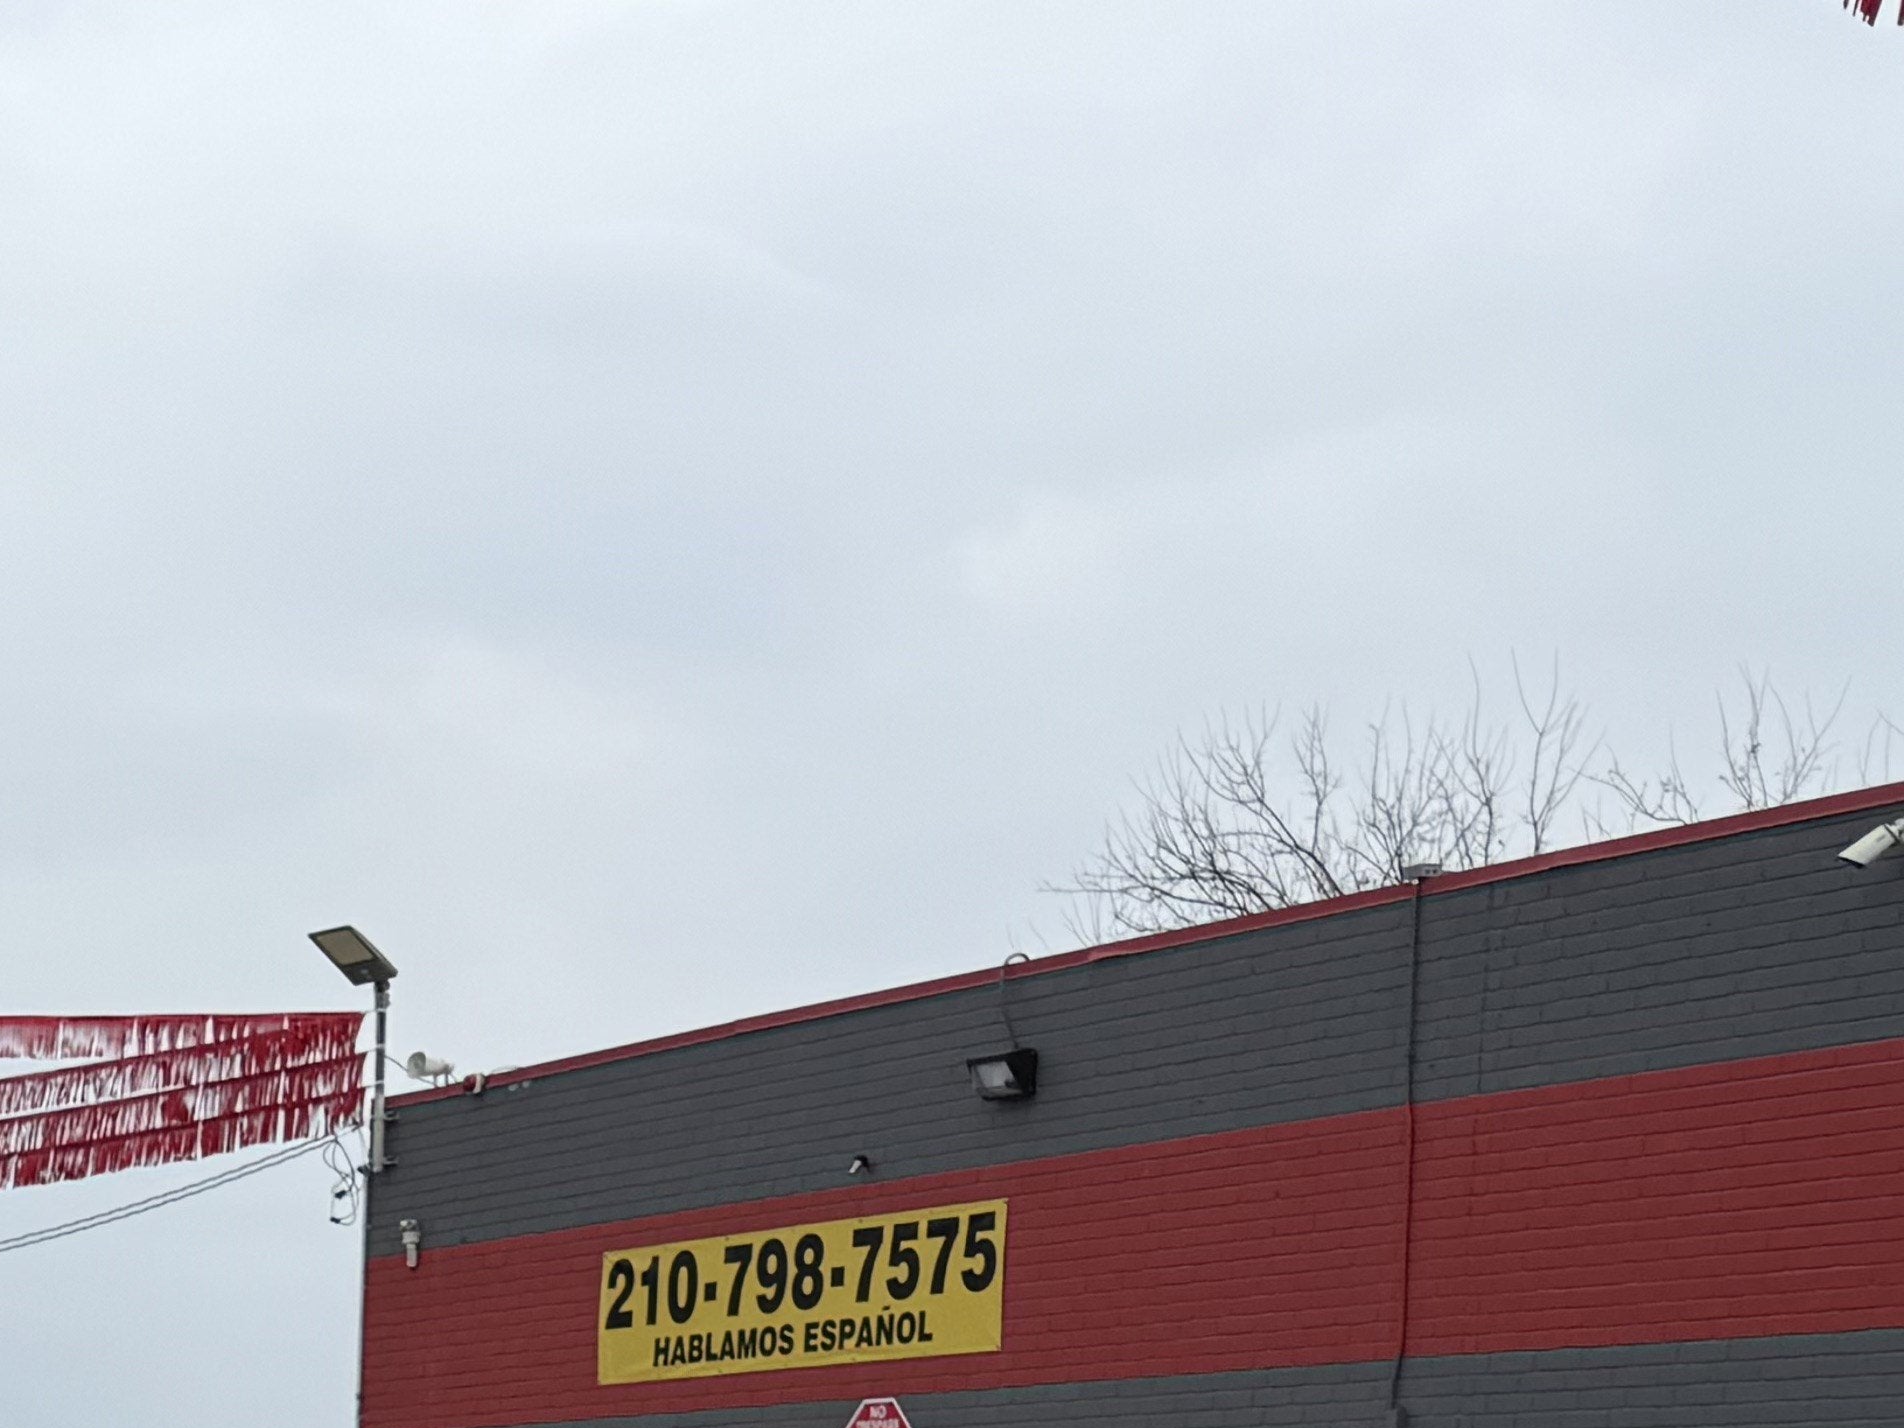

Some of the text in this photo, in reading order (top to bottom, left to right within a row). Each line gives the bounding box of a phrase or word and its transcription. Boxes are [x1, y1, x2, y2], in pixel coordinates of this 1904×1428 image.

[605, 1211, 996, 1329] 210-798-7575
[653, 1306, 933, 1367] HABLAMOS ESPAÑOL
